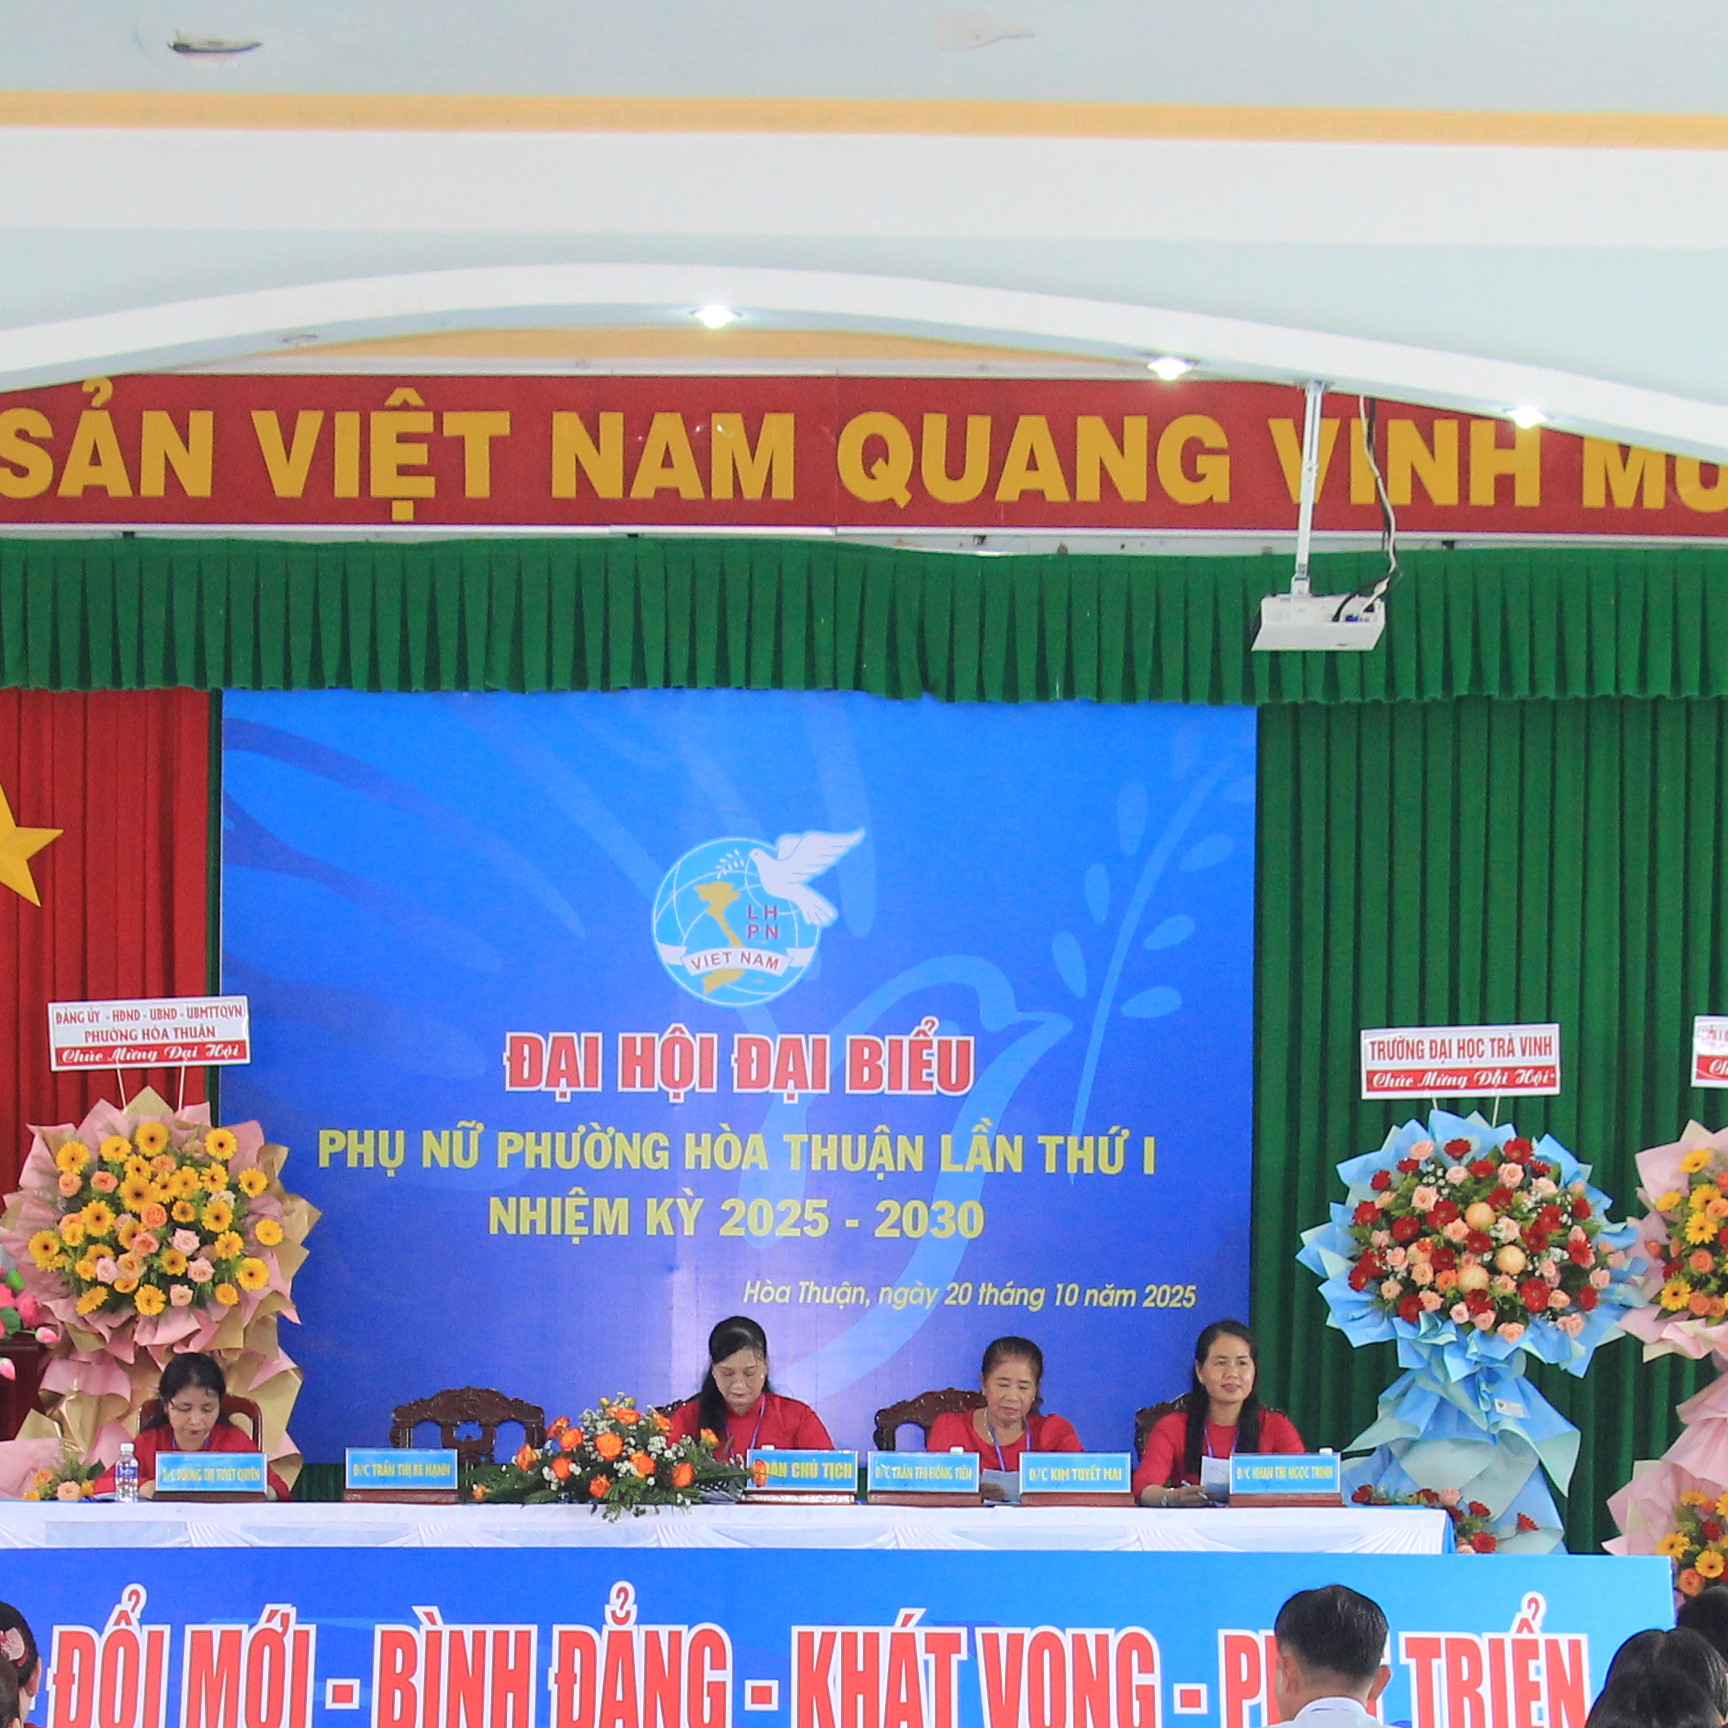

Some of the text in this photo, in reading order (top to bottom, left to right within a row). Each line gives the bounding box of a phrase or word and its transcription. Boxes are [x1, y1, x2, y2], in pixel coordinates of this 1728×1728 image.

[251, 387, 511, 521] VIỆT
[552, 411, 795, 501] NAM
[835, 411, 1231, 508] QUANG
[1267, 416, 1543, 509] VINH
[690, 950, 781, 971] VIET NAM
[503, 1016, 975, 1103] ĐẠI HỘI ĐẠI BIỂU
[1369, 1033, 1553, 1064] TRƯỜNG ĐẠI HỌC TRÀ VINH
[319, 1118, 1156, 1180] PHỤ NỮ PHƯỜNG HÒA THUẬN LẦN THỨ I
[489, 1187, 985, 1244] NHIỆM KỲ 2025 2030
[743, 1279, 1198, 1312] Hòa Thuận, ngày 20 tháng 10 năm 2025
[791, 1458, 819, 1478] CHỦ
[822, 1462, 853, 1481] TỊCH
